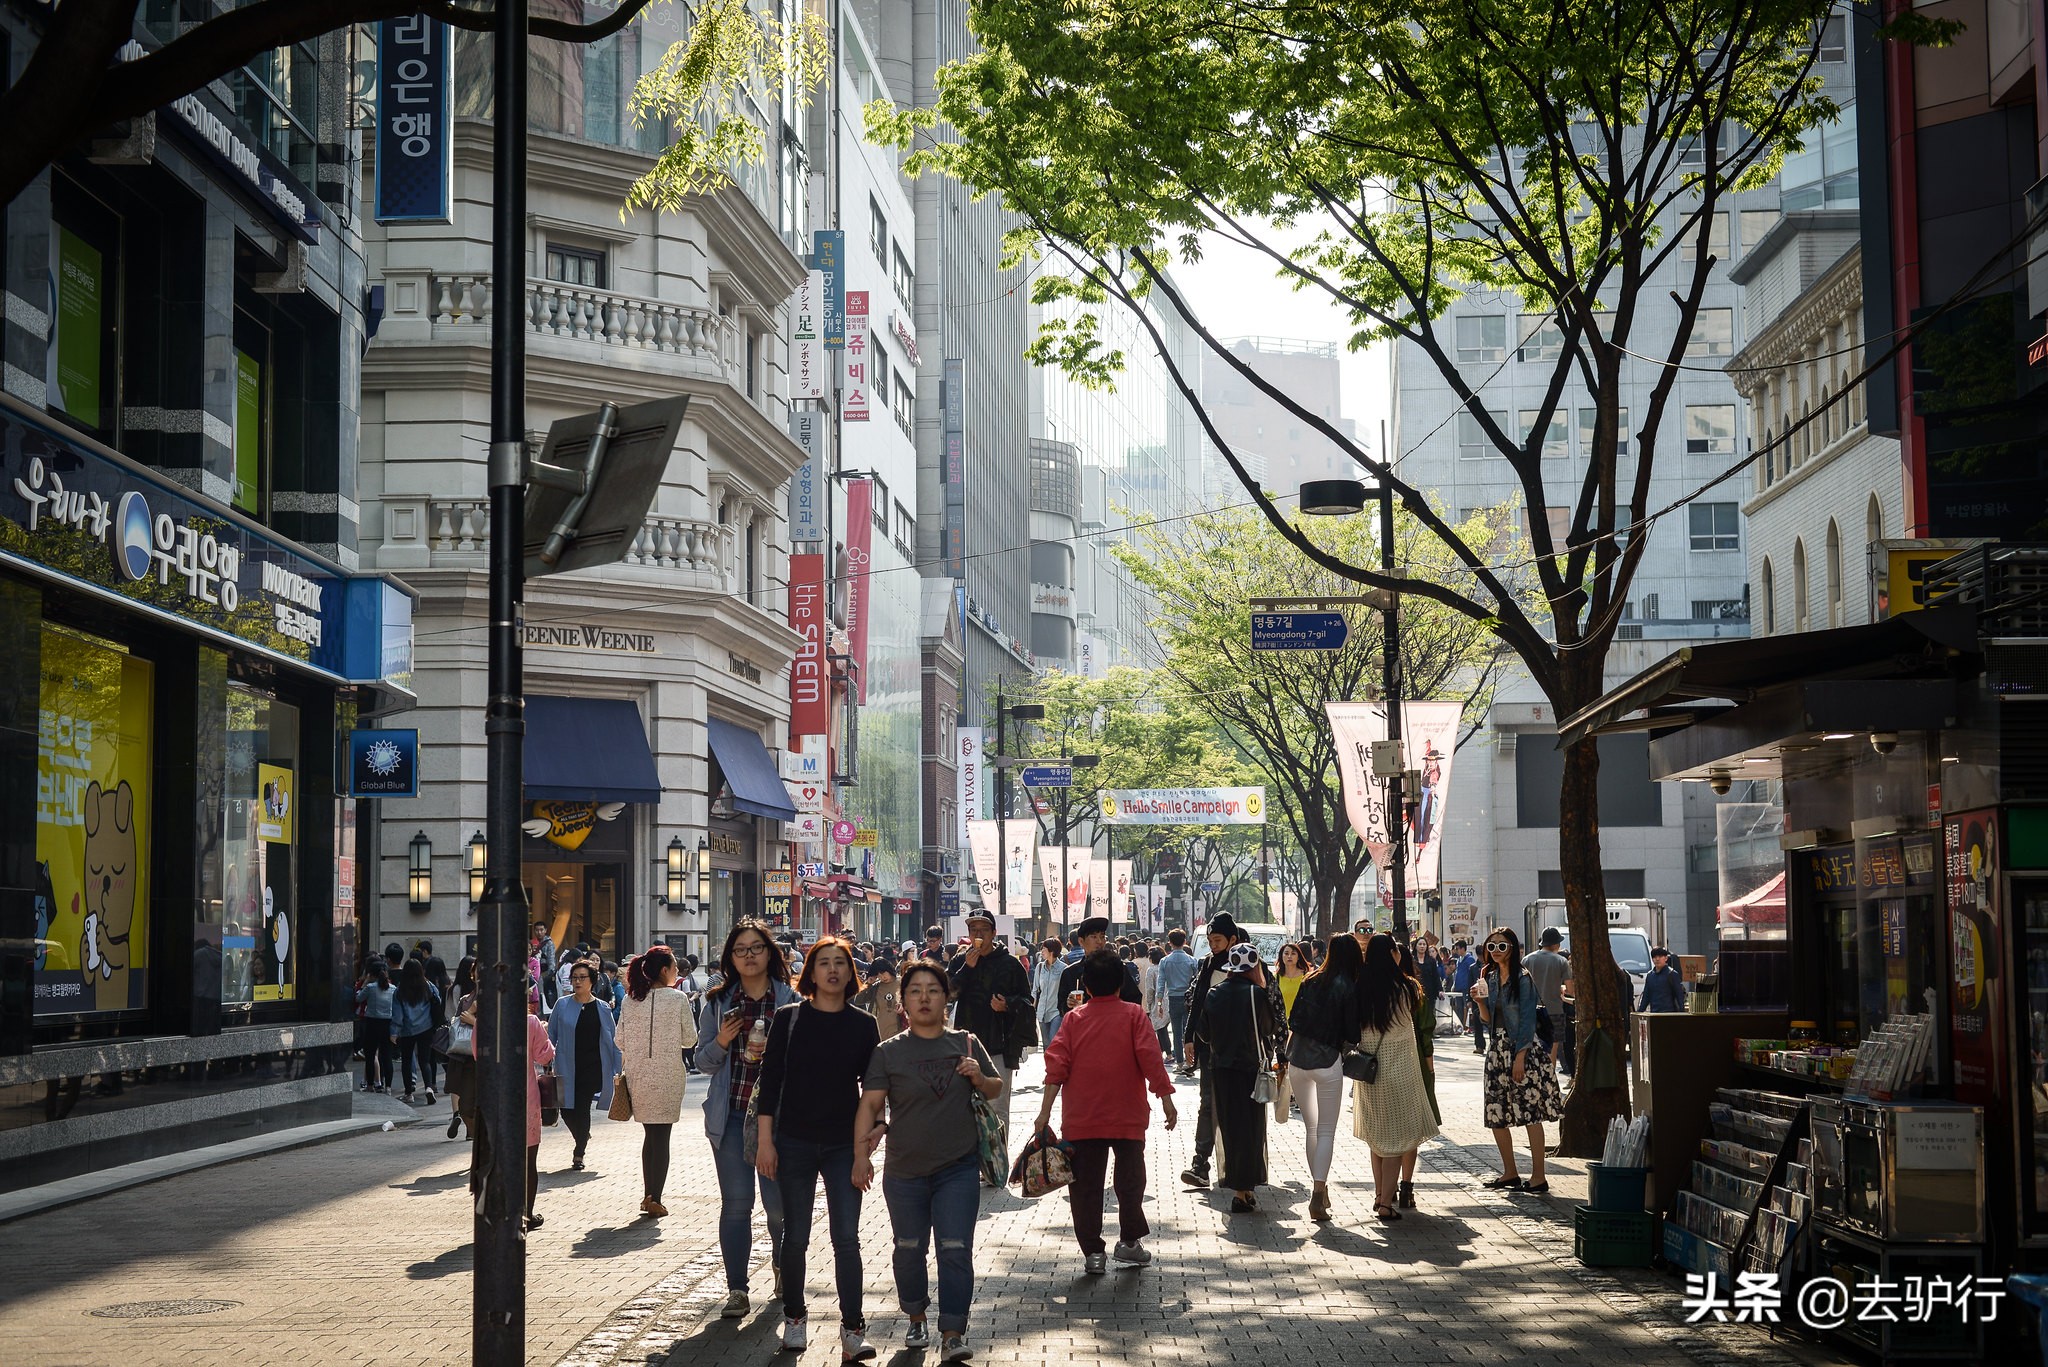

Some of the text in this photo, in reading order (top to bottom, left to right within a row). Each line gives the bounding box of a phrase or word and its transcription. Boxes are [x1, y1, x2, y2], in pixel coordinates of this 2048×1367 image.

[231, 135, 261, 186] BANK
[820, 241, 834, 267] 현대
[798, 315, 813, 332] 足
[846, 335, 866, 406] 쥬비스
[811, 388, 820, 396] 8F
[800, 465, 812, 524] 성형외과
[151, 513, 239, 612] 우리은행
[795, 584, 817, 618] the
[847, 588, 857, 632] SECONDS
[1254, 615, 1293, 629] 명동7길
[525, 625, 655, 653] EENIE WEENIE
[1254, 630, 1327, 640] Myeongdong 7-gil
[803, 758, 816, 771] M
[360, 780, 406, 791] Global Blue
[964, 762, 975, 805] ROYAL
[1122, 799, 1240, 816] Hello Smile Campaign
[764, 871, 790, 883] Cafe
[1448, 887, 1475, 897] 最低价
[765, 897, 790, 914] Hof
